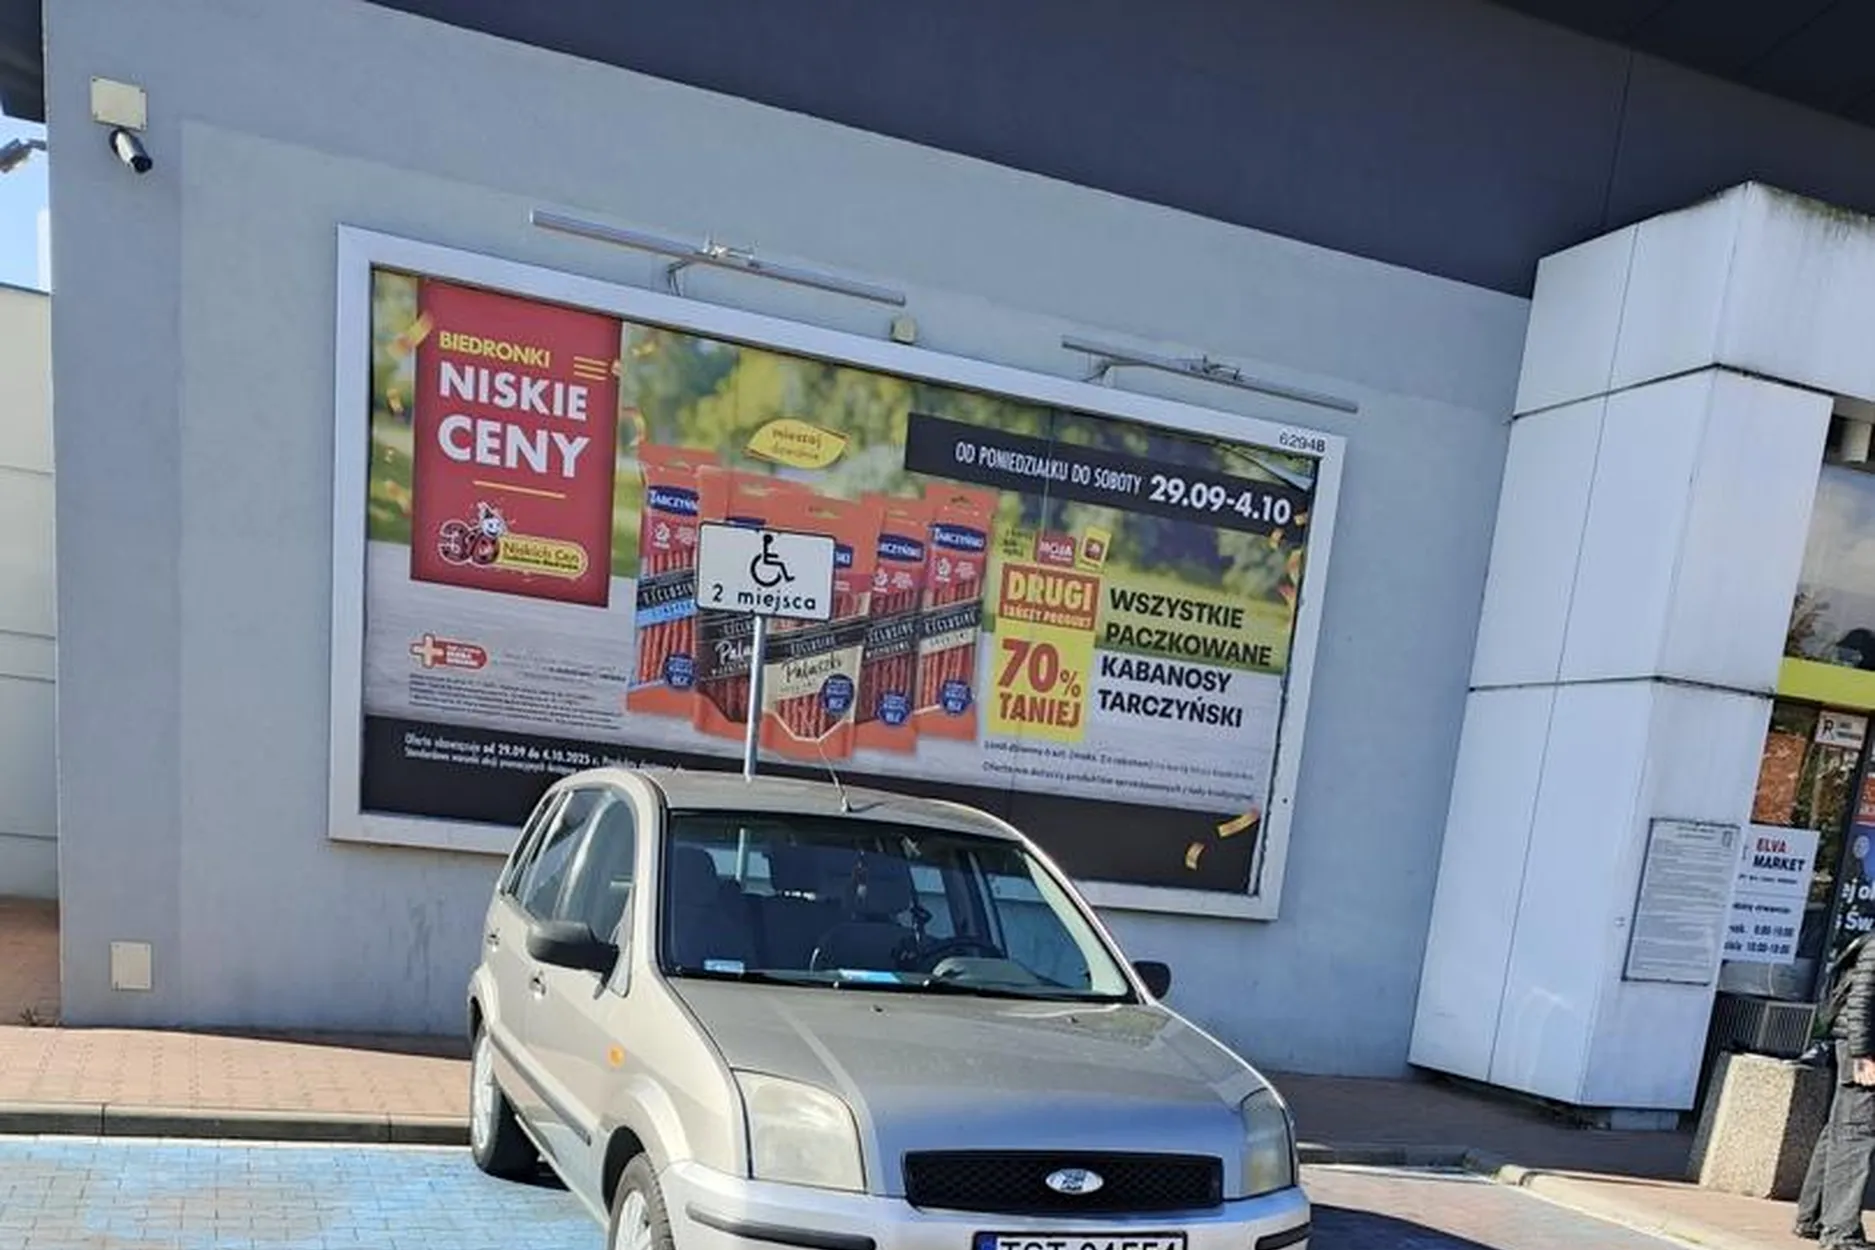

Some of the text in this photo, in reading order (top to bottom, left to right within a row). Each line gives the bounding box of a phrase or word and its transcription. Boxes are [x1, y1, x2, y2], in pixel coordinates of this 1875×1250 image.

[439, 330, 550, 368] BIEDRONKI
[440, 361, 588, 421] NISKIE
[438, 414, 591, 478] CENY
[955, 441, 1291, 525] OD PONIEDZIAŁKU DO SOBOTY 29.09-4.10
[712, 583, 816, 611] 2 miejsca
[1007, 571, 1093, 612] DRUGI
[1109, 587, 1245, 629] WSZYSTKIE
[1105, 622, 1272, 667] PACZKOWANE
[998, 638, 1081, 698] 70%
[1101, 655, 1232, 693] KABANOSY
[1000, 691, 1080, 728] TANIEJ
[1098, 689, 1243, 728] TARCZYŃSKI
[1752, 855, 1806, 872] MARKET
[1756, 837, 1788, 853] ELVA
